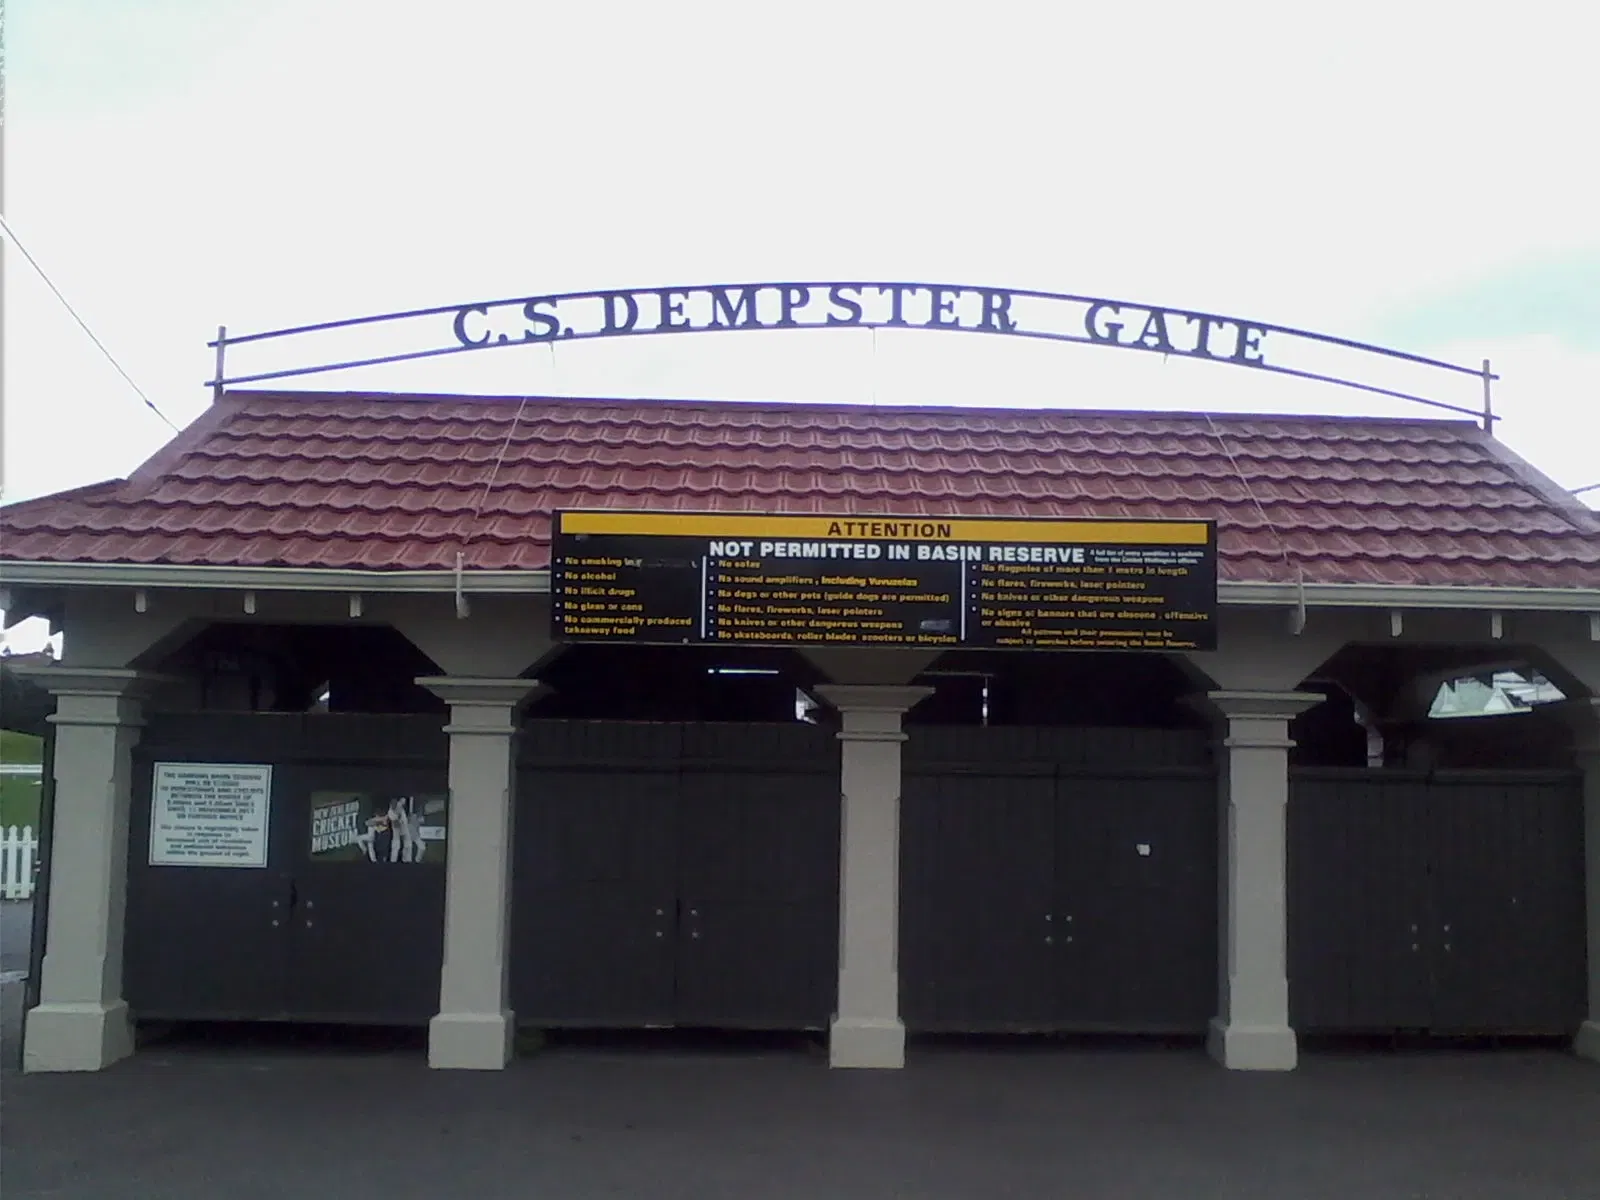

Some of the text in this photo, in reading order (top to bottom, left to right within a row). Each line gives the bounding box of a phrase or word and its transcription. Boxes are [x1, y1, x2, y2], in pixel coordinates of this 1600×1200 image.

[600, 284, 1017, 333] DEMPSTER
[1085, 301, 1266, 366] GATE
[827, 521, 951, 537] ATTENTION
[709, 541, 1085, 563] NOT PERMITTED IN BASIN RESERVE
[564, 557, 579, 566] No
[581, 557, 622, 568] smoking
[718, 559, 733, 568] No
[981, 563, 995, 573] No
[564, 571, 617, 581] No alcohol
[718, 574, 732, 583] No
[734, 575, 764, 584] sound
[981, 578, 995, 588] No
[1106, 581, 1146, 591] pointers
[564, 586, 636, 597] No illicit drugs
[718, 589, 732, 598] No
[734, 589, 758, 600] dogs
[772, 590, 799, 599] other
[800, 591, 821, 601] pets
[856, 592, 879, 603] dogs
[881, 594, 897, 602] are
[899, 593, 950, 604] permitted)
[981, 592, 995, 602] No
[564, 602, 579, 611] No
[581, 602, 606, 612] glass
[718, 604, 732, 613] No
[817, 606, 841, 615] laser
[843, 607, 883, 617] pointers
[981, 607, 995, 617] No
[564, 615, 692, 626] No commercially produced
[718, 617, 904, 630] No knives or other dangerous weapons
[994, 619, 1031, 628] abusive
[564, 626, 636, 636] takeaway food
[718, 631, 732, 639] No
[797, 632, 824, 641] roller
[861, 633, 904, 643] scooters
[905, 635, 916, 643] or
[918, 633, 957, 644] bicycles
[312, 811, 358, 836] CRICKET
[311, 828, 358, 854] MUSEUM
